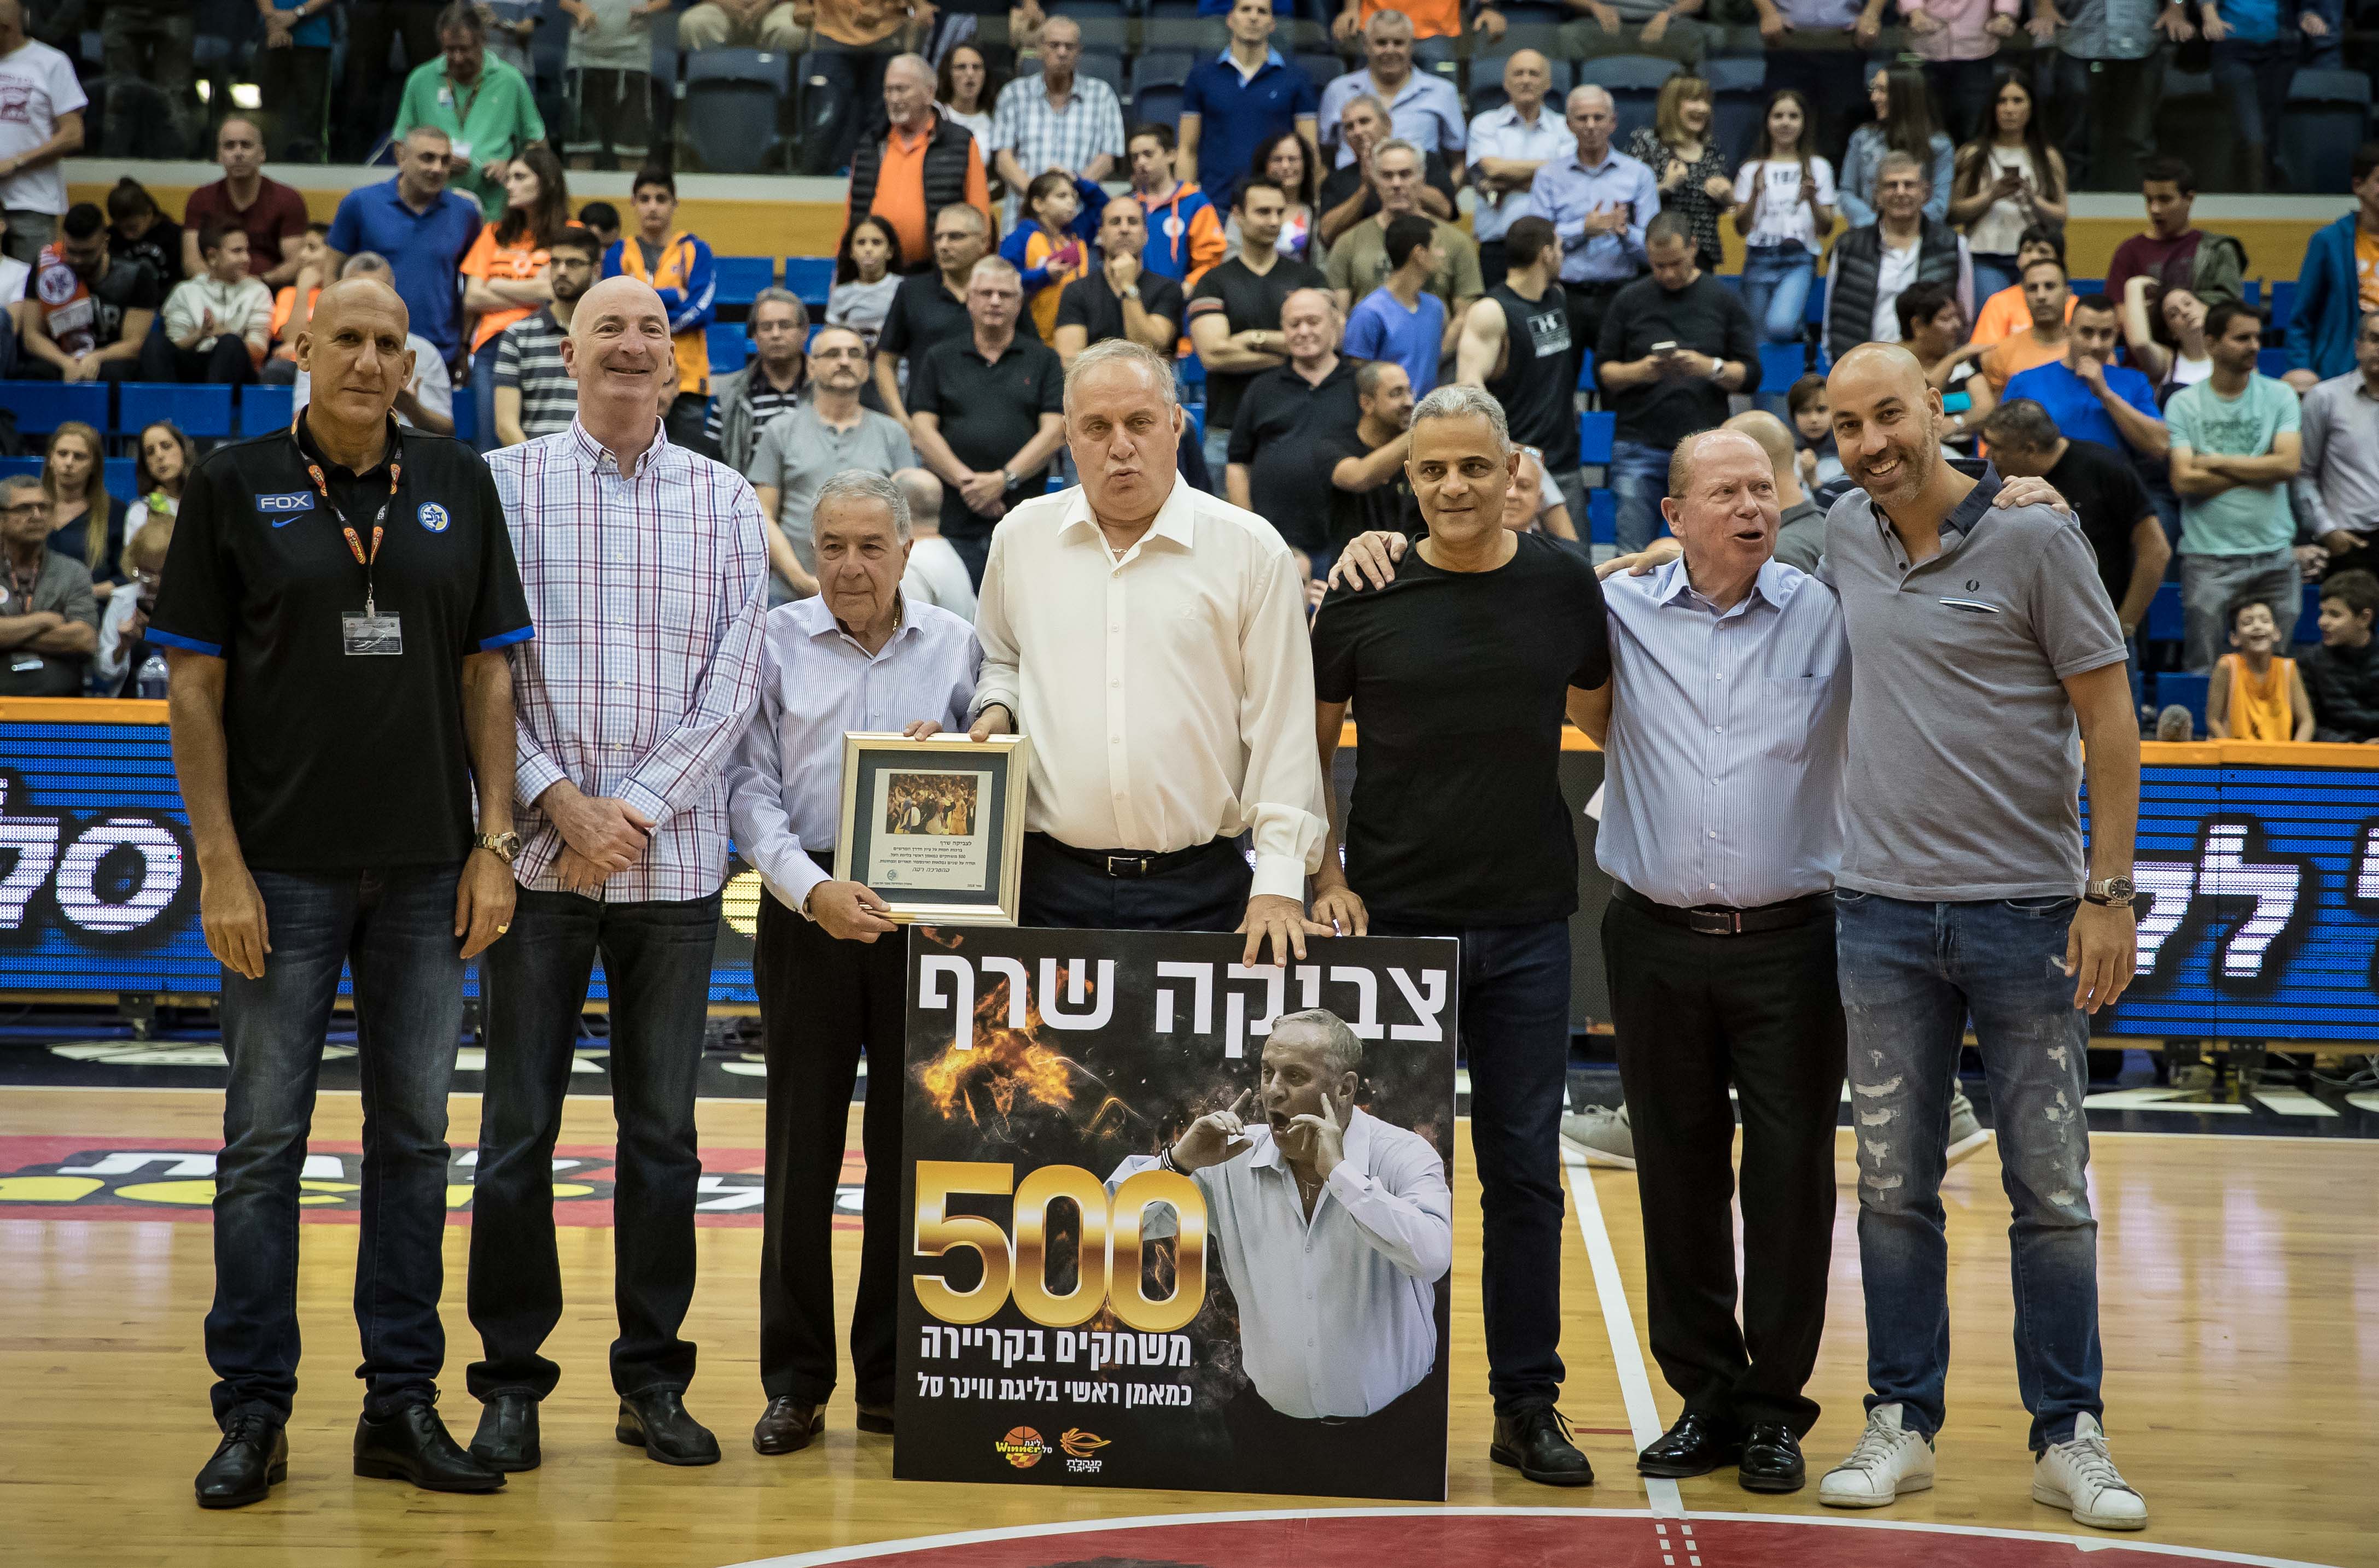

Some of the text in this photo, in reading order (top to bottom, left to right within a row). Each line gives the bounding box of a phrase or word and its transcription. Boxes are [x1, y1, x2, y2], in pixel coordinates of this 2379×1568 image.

[261, 494, 309, 508] FOX
[919, 955, 1448, 1058] צביקה שרף
[913, 1160, 1208, 1332] 500
[921, 1326, 1191, 1371] משחקים בקריירה
[917, 1372, 1192, 1408] כמאמן ראשי בליגת ווינר סל
[995, 1441, 1041, 1453] Winner
[1042, 1444, 1053, 1454] סל
[1066, 1458, 1102, 1466] מנהלת
